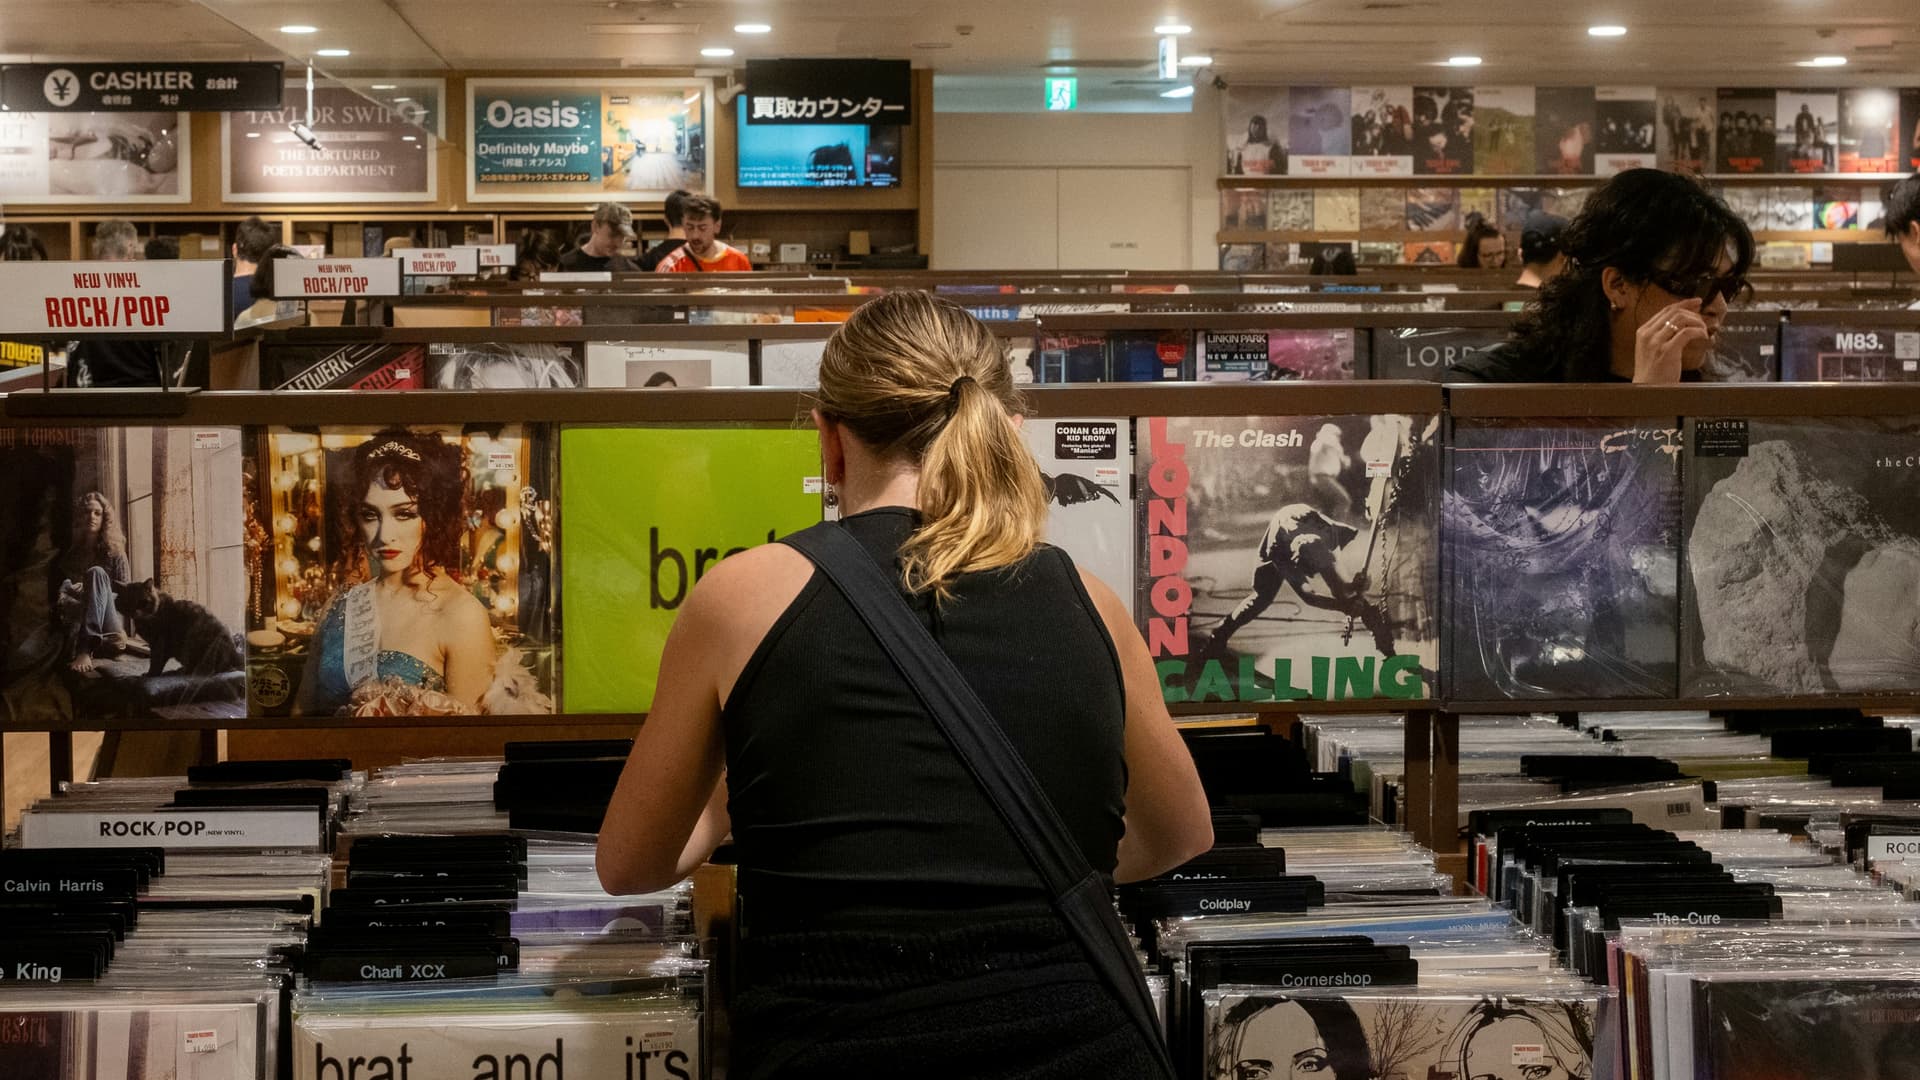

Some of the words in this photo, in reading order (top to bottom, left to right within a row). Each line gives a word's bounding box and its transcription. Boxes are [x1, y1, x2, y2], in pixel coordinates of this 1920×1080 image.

[90, 72, 194, 90] CASHIER
[487, 100, 580, 129] Oasis
[753, 97, 905, 119] 買取カウンター
[279, 149, 308, 161] THE
[312, 149, 380, 161] TORTURED
[478, 143, 541, 157] Definitely
[544, 142, 589, 157] Maybe
[263, 165, 303, 177] POETS
[306, 165, 396, 177] DEPARTMENT
[318, 264, 333, 273] NEW
[335, 264, 353, 273] VINYL
[412, 261, 457, 272] ROCK/POP
[73, 273, 101, 289] NEW
[104, 272, 141, 288] VINYL
[303, 277, 369, 293] ROCK/POP
[45, 296, 170, 328] ROCK/POP
[1207, 334, 1240, 344] LINKIN
[1240, 333, 1266, 344] PARK
[1836, 333, 1884, 350] M83.
[1, 341, 43, 363] TOWER
[1056, 427, 1089, 435] CONAN
[1091, 427, 1116, 436] GRAY
[1193, 429, 1235, 448] The
[1239, 428, 1303, 448] Clash
[1148, 416, 1193, 657] LONDON
[649, 526, 776, 610] br
[1154, 655, 1424, 701] CALLING
[100, 821, 205, 836] ROCK/POP
[1887, 843, 1920, 854] ROC
[4, 880, 51, 892] Calvin
[59, 879, 104, 892] Harris
[1200, 899, 1251, 911] Coldplay
[1653, 911, 1682, 924] The
[1688, 911, 1721, 924] Cure
[17, 963, 62, 982] King
[360, 965, 403, 979] Charli
[410, 965, 446, 978] XCX
[1282, 973, 1371, 988] Cornershop
